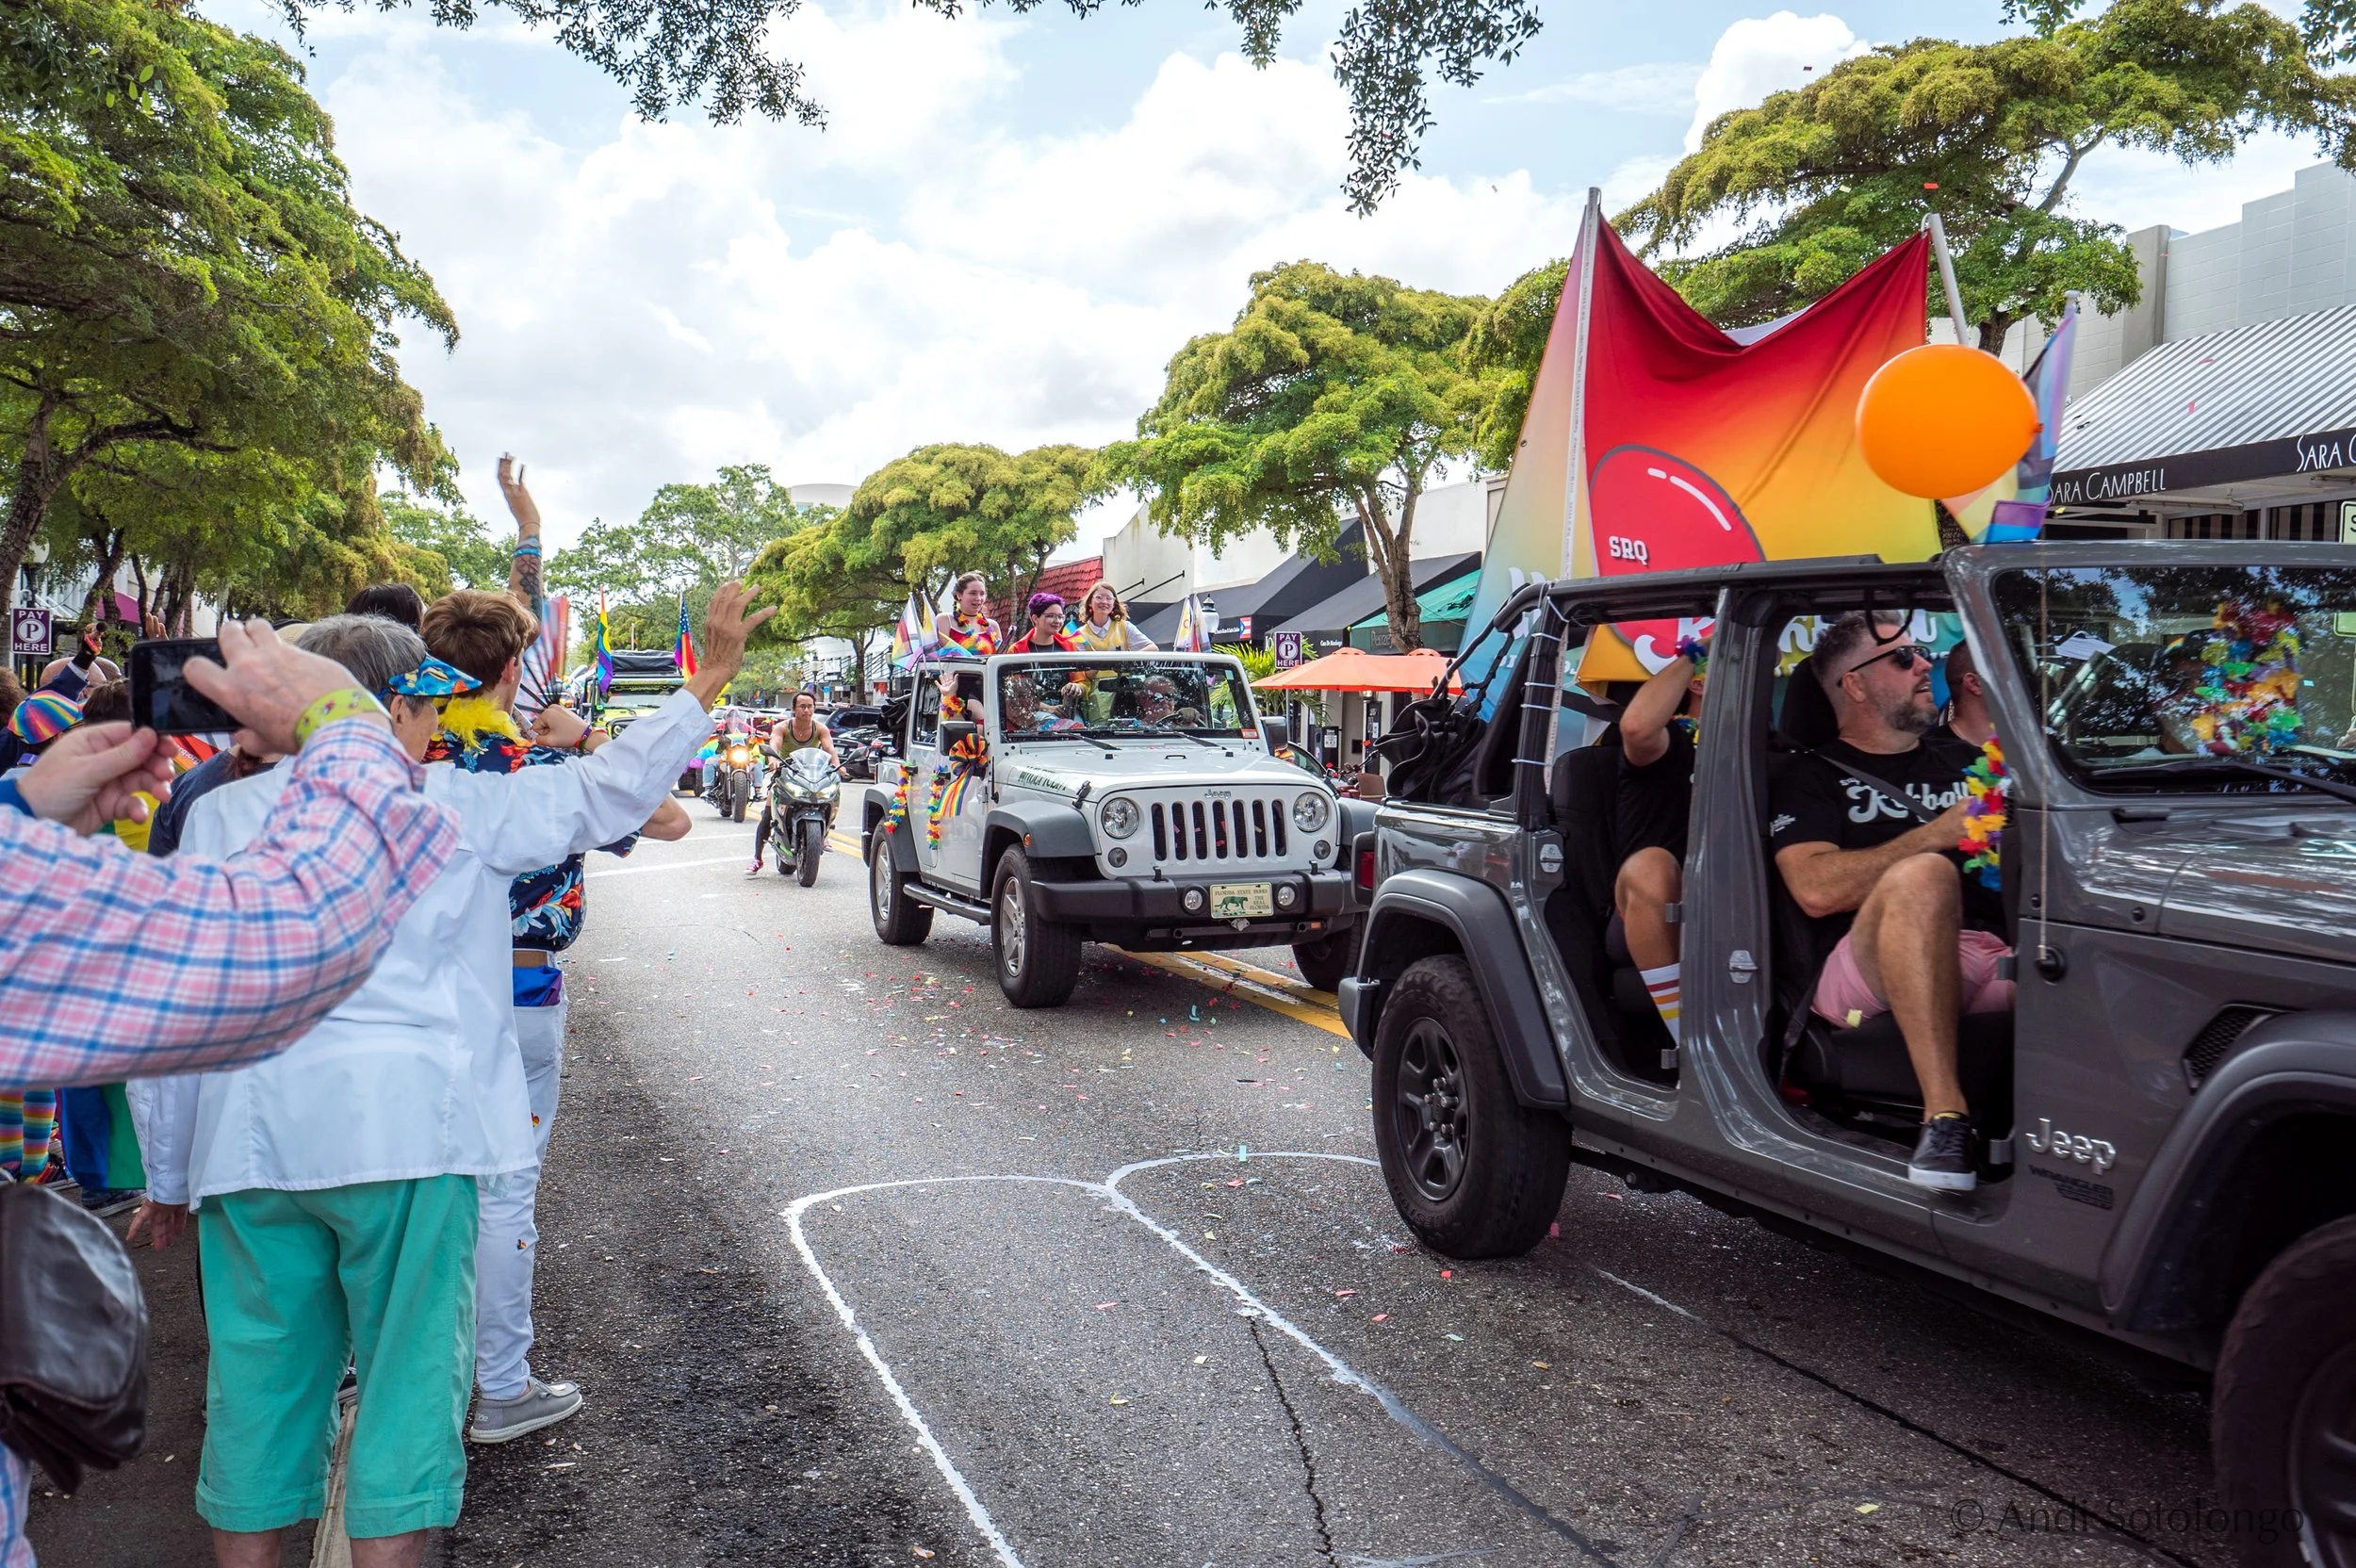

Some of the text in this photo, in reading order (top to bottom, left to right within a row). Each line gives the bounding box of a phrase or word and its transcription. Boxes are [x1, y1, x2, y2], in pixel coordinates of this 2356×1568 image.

[2297, 435, 2343, 472] SARA
[2086, 468, 2167, 500] CAMPBELL
[1609, 535, 1648, 565] SRQ
[19, 611, 44, 619] PAY
[14, 643, 48, 651] HERE
[1204, 789, 1232, 799] Jeep
[1845, 782, 1970, 825] Kball
[2025, 1118, 2117, 1176] Jeep
